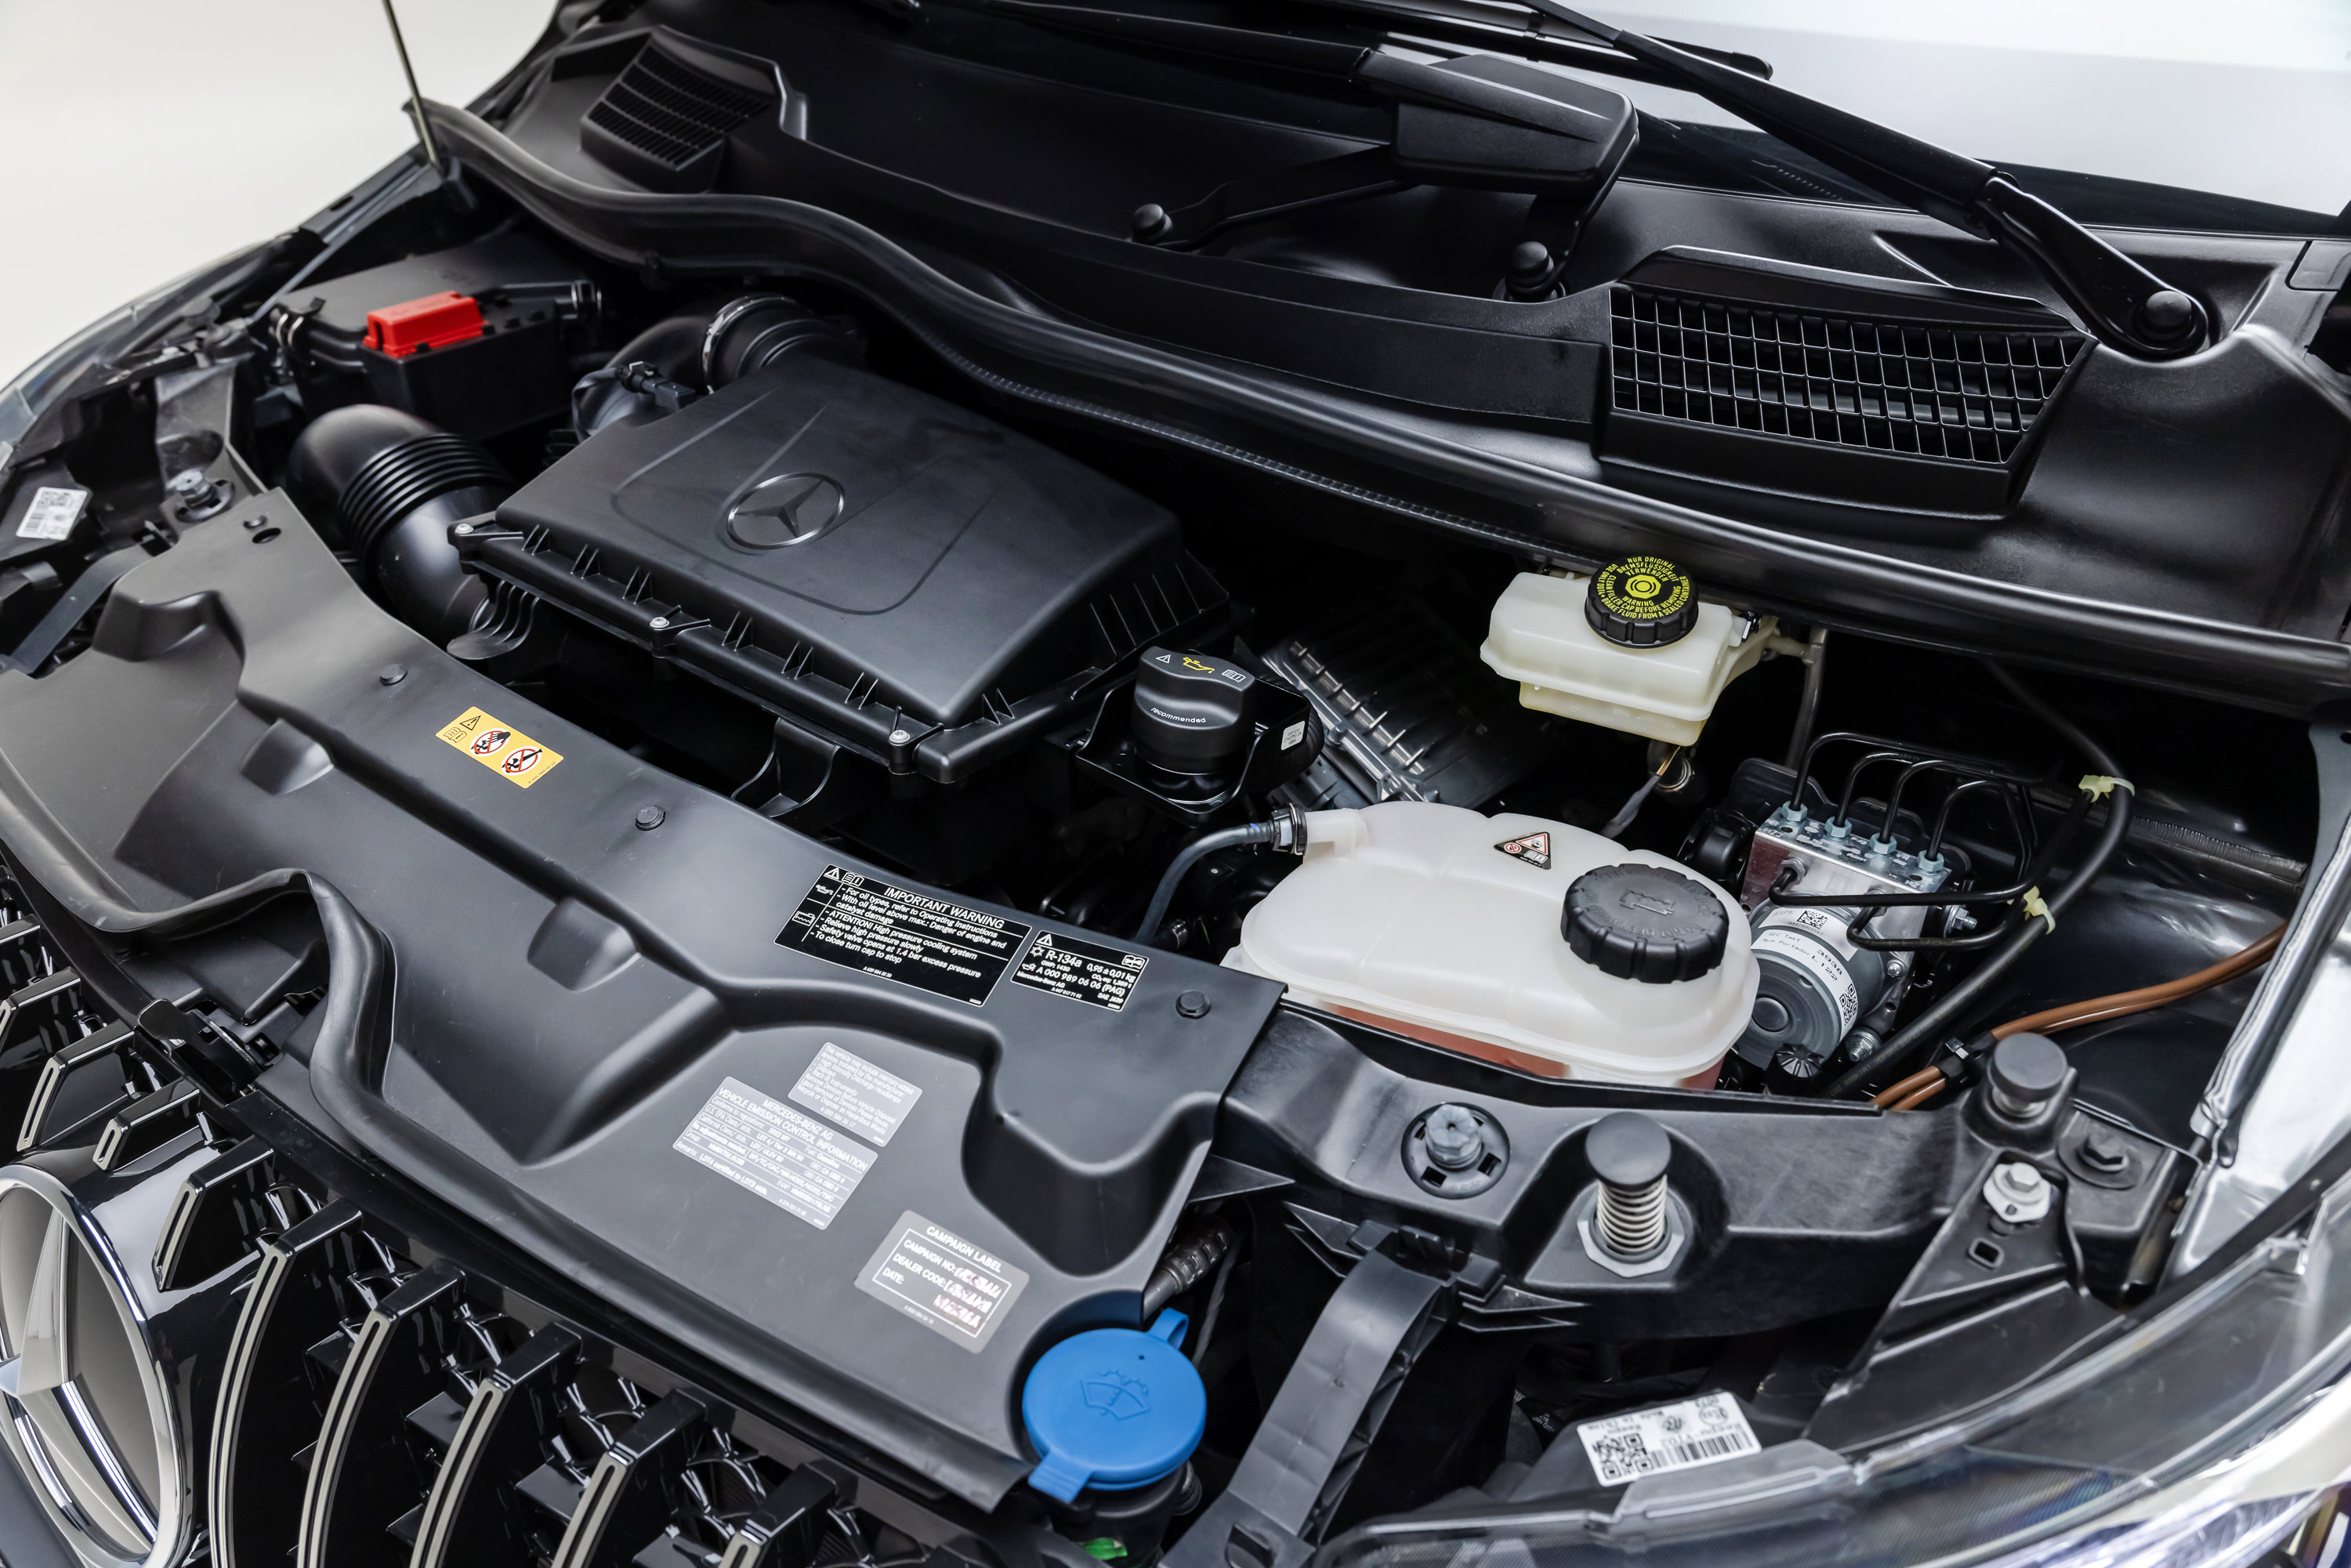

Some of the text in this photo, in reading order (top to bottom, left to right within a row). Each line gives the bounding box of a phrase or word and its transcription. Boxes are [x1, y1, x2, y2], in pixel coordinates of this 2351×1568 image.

[1605, 563, 1618, 573] USE
[1616, 562, 1679, 581] BREMSFLÜSSIGKEIT
[1625, 567, 1669, 582] VERWENDEN
[1645, 556, 1675, 570] ORIGINAL
[1599, 571, 1610, 583] ONLY
[1606, 574, 1617, 590] CLEAN
[1679, 575, 1690, 602] CONTAINER
[1601, 597, 1620, 612] BRAKE
[1606, 589, 1623, 606] FILLER
[1622, 596, 1654, 607] WARNING
[1635, 604, 1662, 613] BEFORE
[1661, 585, 1682, 609] REMOVING
[1662, 599, 1684, 616] SEALED
[1617, 608, 1637, 619] FLUID
[1150, 707, 1206, 723] recommended
[836, 902, 893, 925] catalyst damage
[842, 893, 858, 904] With
[868, 902, 888, 914] level
[886, 910, 908, 920] above
[929, 922, 956, 934] Danger
[965, 933, 991, 943] engine
[846, 887, 859, 896] For
[869, 896, 889, 907] types,
[891, 902, 910, 912] refer
[919, 911, 955, 926] Operating
[955, 921, 998, 938] Instructions
[884, 887, 1004, 929] IMPORTANT WARNING
[824, 917, 924, 953] Relieve high pressure slowly
[828, 911, 977, 959] ATTENTION! High pressure cooling system
[815, 931, 824, 940] To
[824, 936, 845, 946] close
[845, 941, 861, 951] turn
[860, 946, 875, 956] cap
[884, 954, 902, 964] stop
[819, 924, 844, 937] Safety
[843, 932, 862, 943] valve
[863, 937, 886, 950] opens
[896, 947, 908, 956] 1.4
[907, 951, 922, 960] bar
[922, 956, 947, 968] excess
[947, 964, 981, 977] pressure
[1045, 950, 1082, 967] R-134a
[1817, 950, 1842, 976] 3938
[1044, 969, 1060, 978] 000
[1061, 972, 1078, 983] 989
[1078, 977, 1089, 986] 06
[1089, 980, 1102, 989] 06
[1101, 983, 1125, 997] (PAG)
[719, 1088, 868, 1171] VEHICLE EMISSION CONTROL INFORMATION
[763, 1099, 833, 1140] MERCEDES-BENZ AG
[904, 1240, 956, 1273] CAMPAIGN NO:
[926, 1226, 1001, 1273] CAMPAIGN LABEL
[882, 1267, 904, 1284] DATE:
[893, 1253, 922, 1274] DEALER
[922, 1269, 946, 1287] CODE:
